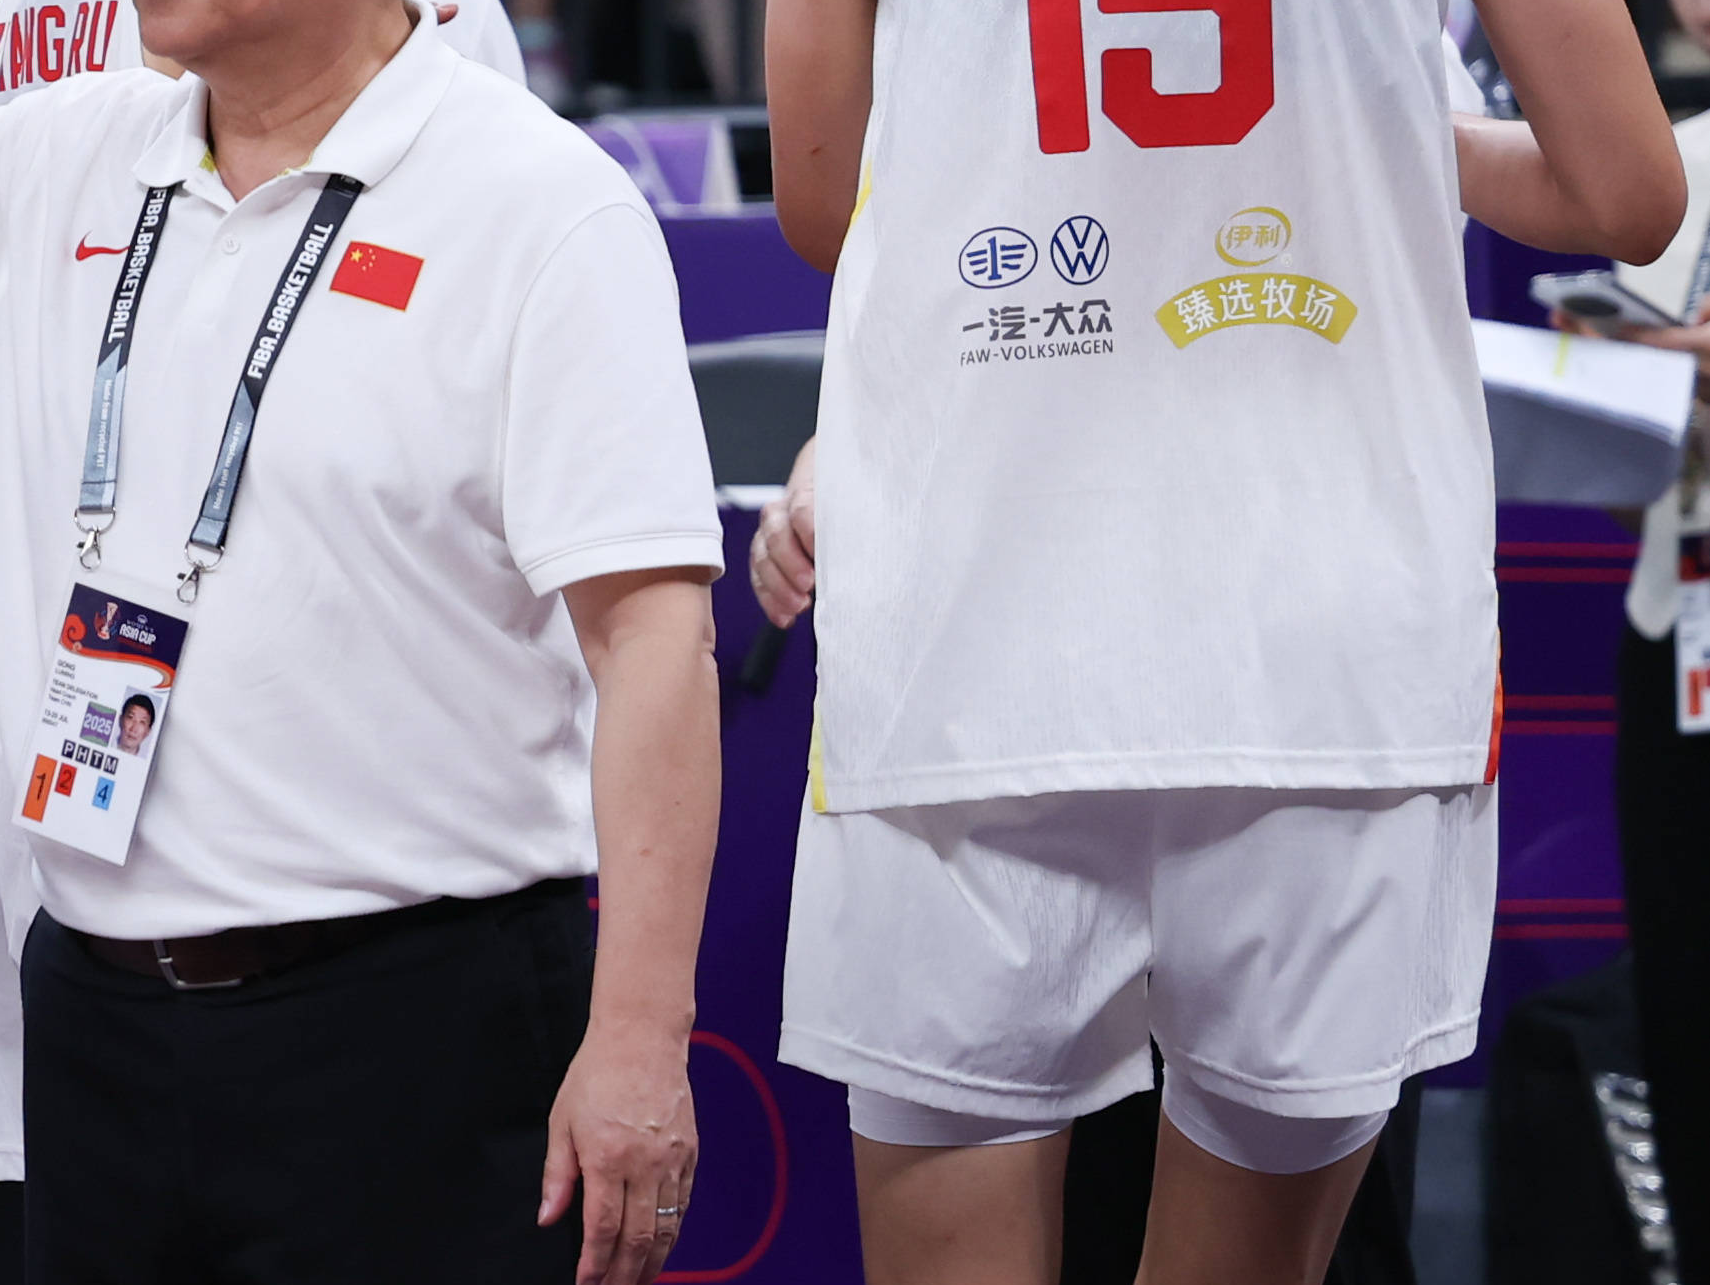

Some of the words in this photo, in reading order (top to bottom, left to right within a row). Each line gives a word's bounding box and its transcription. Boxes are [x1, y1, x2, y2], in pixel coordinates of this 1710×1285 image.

[1224, 223, 1282, 250] 伊利
[247, 223, 334, 380] FIBA.BASKETBALL
[1174, 277, 1339, 335] 臻选牧场
[959, 338, 1114, 367] FAW-VOLKSWAGEN
[138, 630, 157, 645] CUP
[83, 712, 113, 737] 2025
[36, 773, 46, 801] 1
[59, 770, 72, 789] 2
[98, 783, 108, 803] 4
